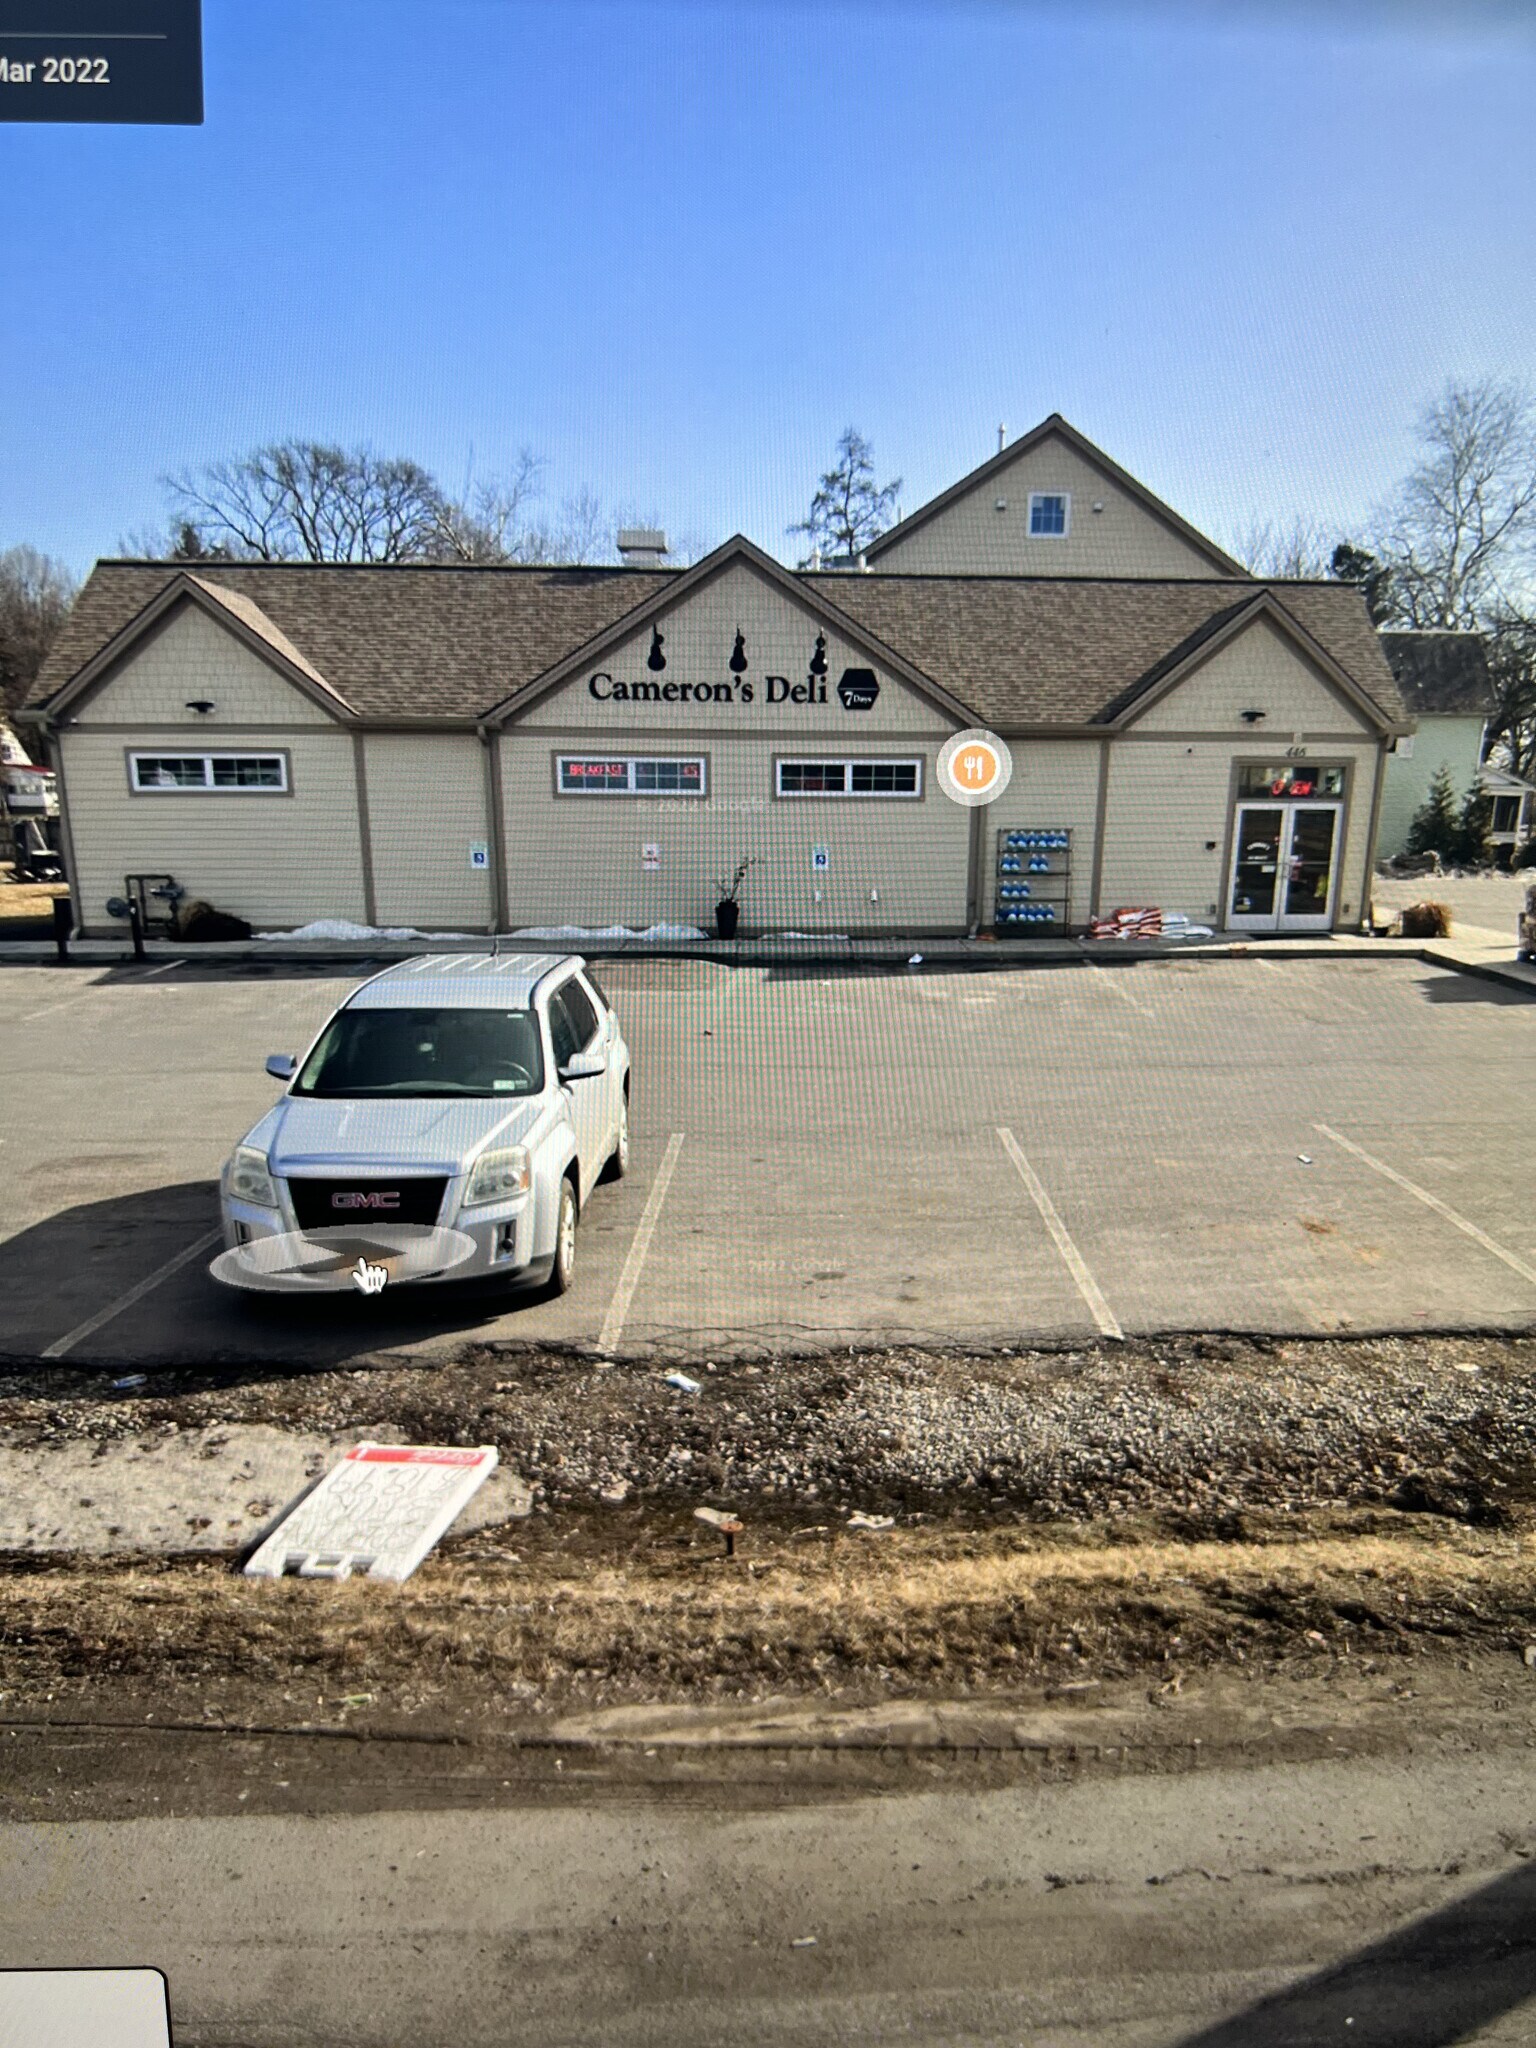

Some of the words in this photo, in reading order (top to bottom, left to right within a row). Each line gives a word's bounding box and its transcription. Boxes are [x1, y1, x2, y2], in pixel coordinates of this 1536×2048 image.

[42, 57, 110, 84] 2022
[589, 673, 754, 703] Cameron's
[766, 675, 828, 703] Deli
[844, 691, 853, 706] 7
[853, 694, 872, 704] Days
[569, 763, 623, 777] BREAKFAST
[1271, 779, 1313, 796] OEN
[332, 1192, 400, 1208] GMC
